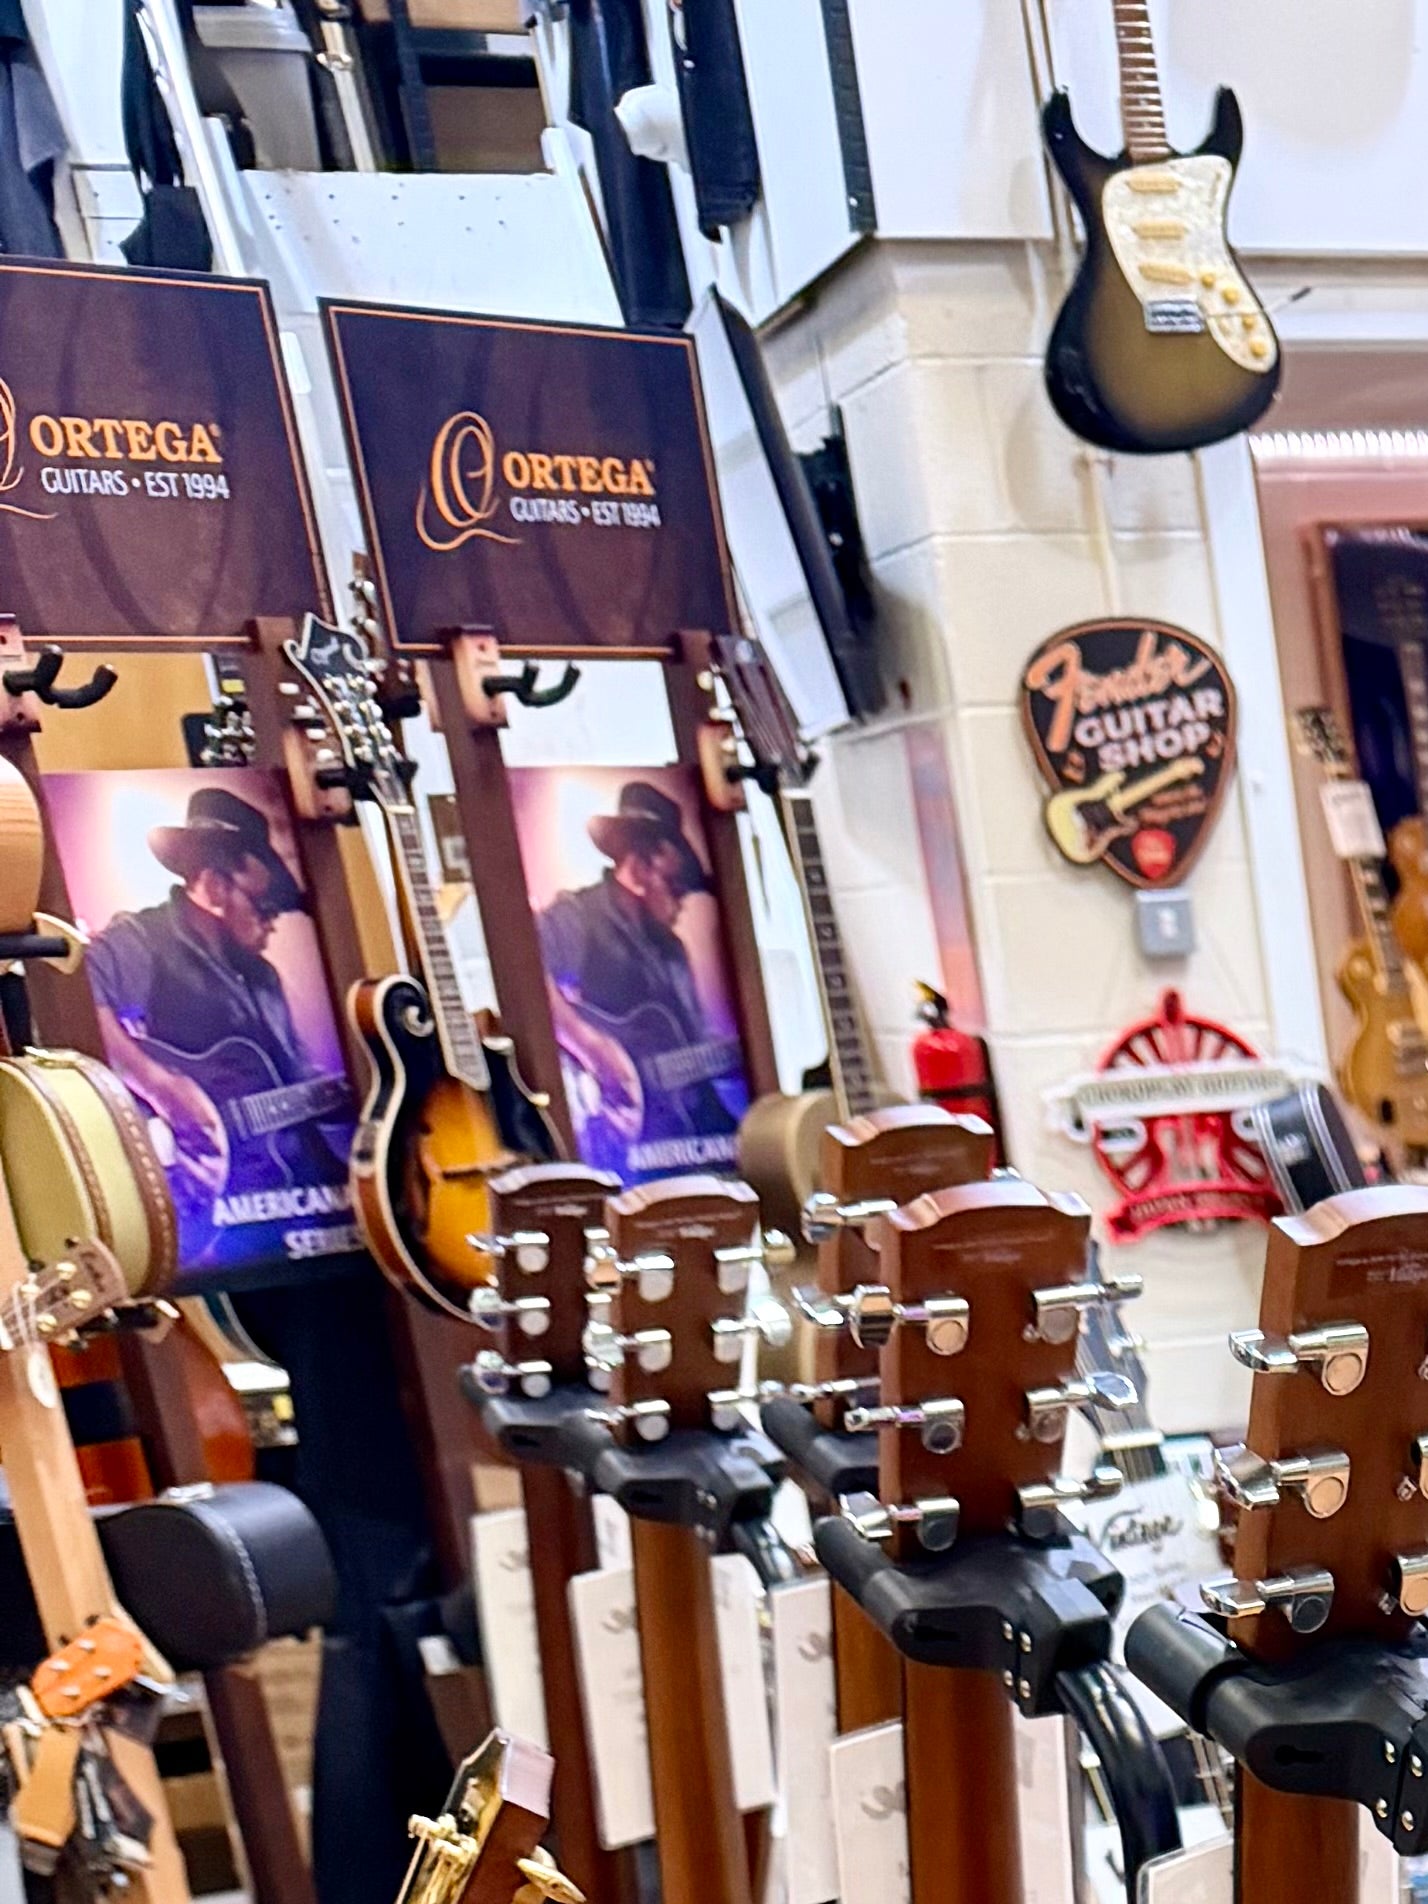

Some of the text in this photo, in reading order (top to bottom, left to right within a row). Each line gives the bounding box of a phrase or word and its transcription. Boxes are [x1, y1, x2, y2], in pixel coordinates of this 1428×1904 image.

[29, 414, 223, 463] ORTEGA
[41, 467, 230, 499] GUITARS EST 1994
[502, 450, 656, 496] ORTEGA
[509, 496, 582, 525] GUITARS
[590, 500, 621, 526] EST
[1025, 631, 1213, 752] Fender
[1074, 687, 1224, 748] GUITAR
[1097, 722, 1211, 773] SHOP
